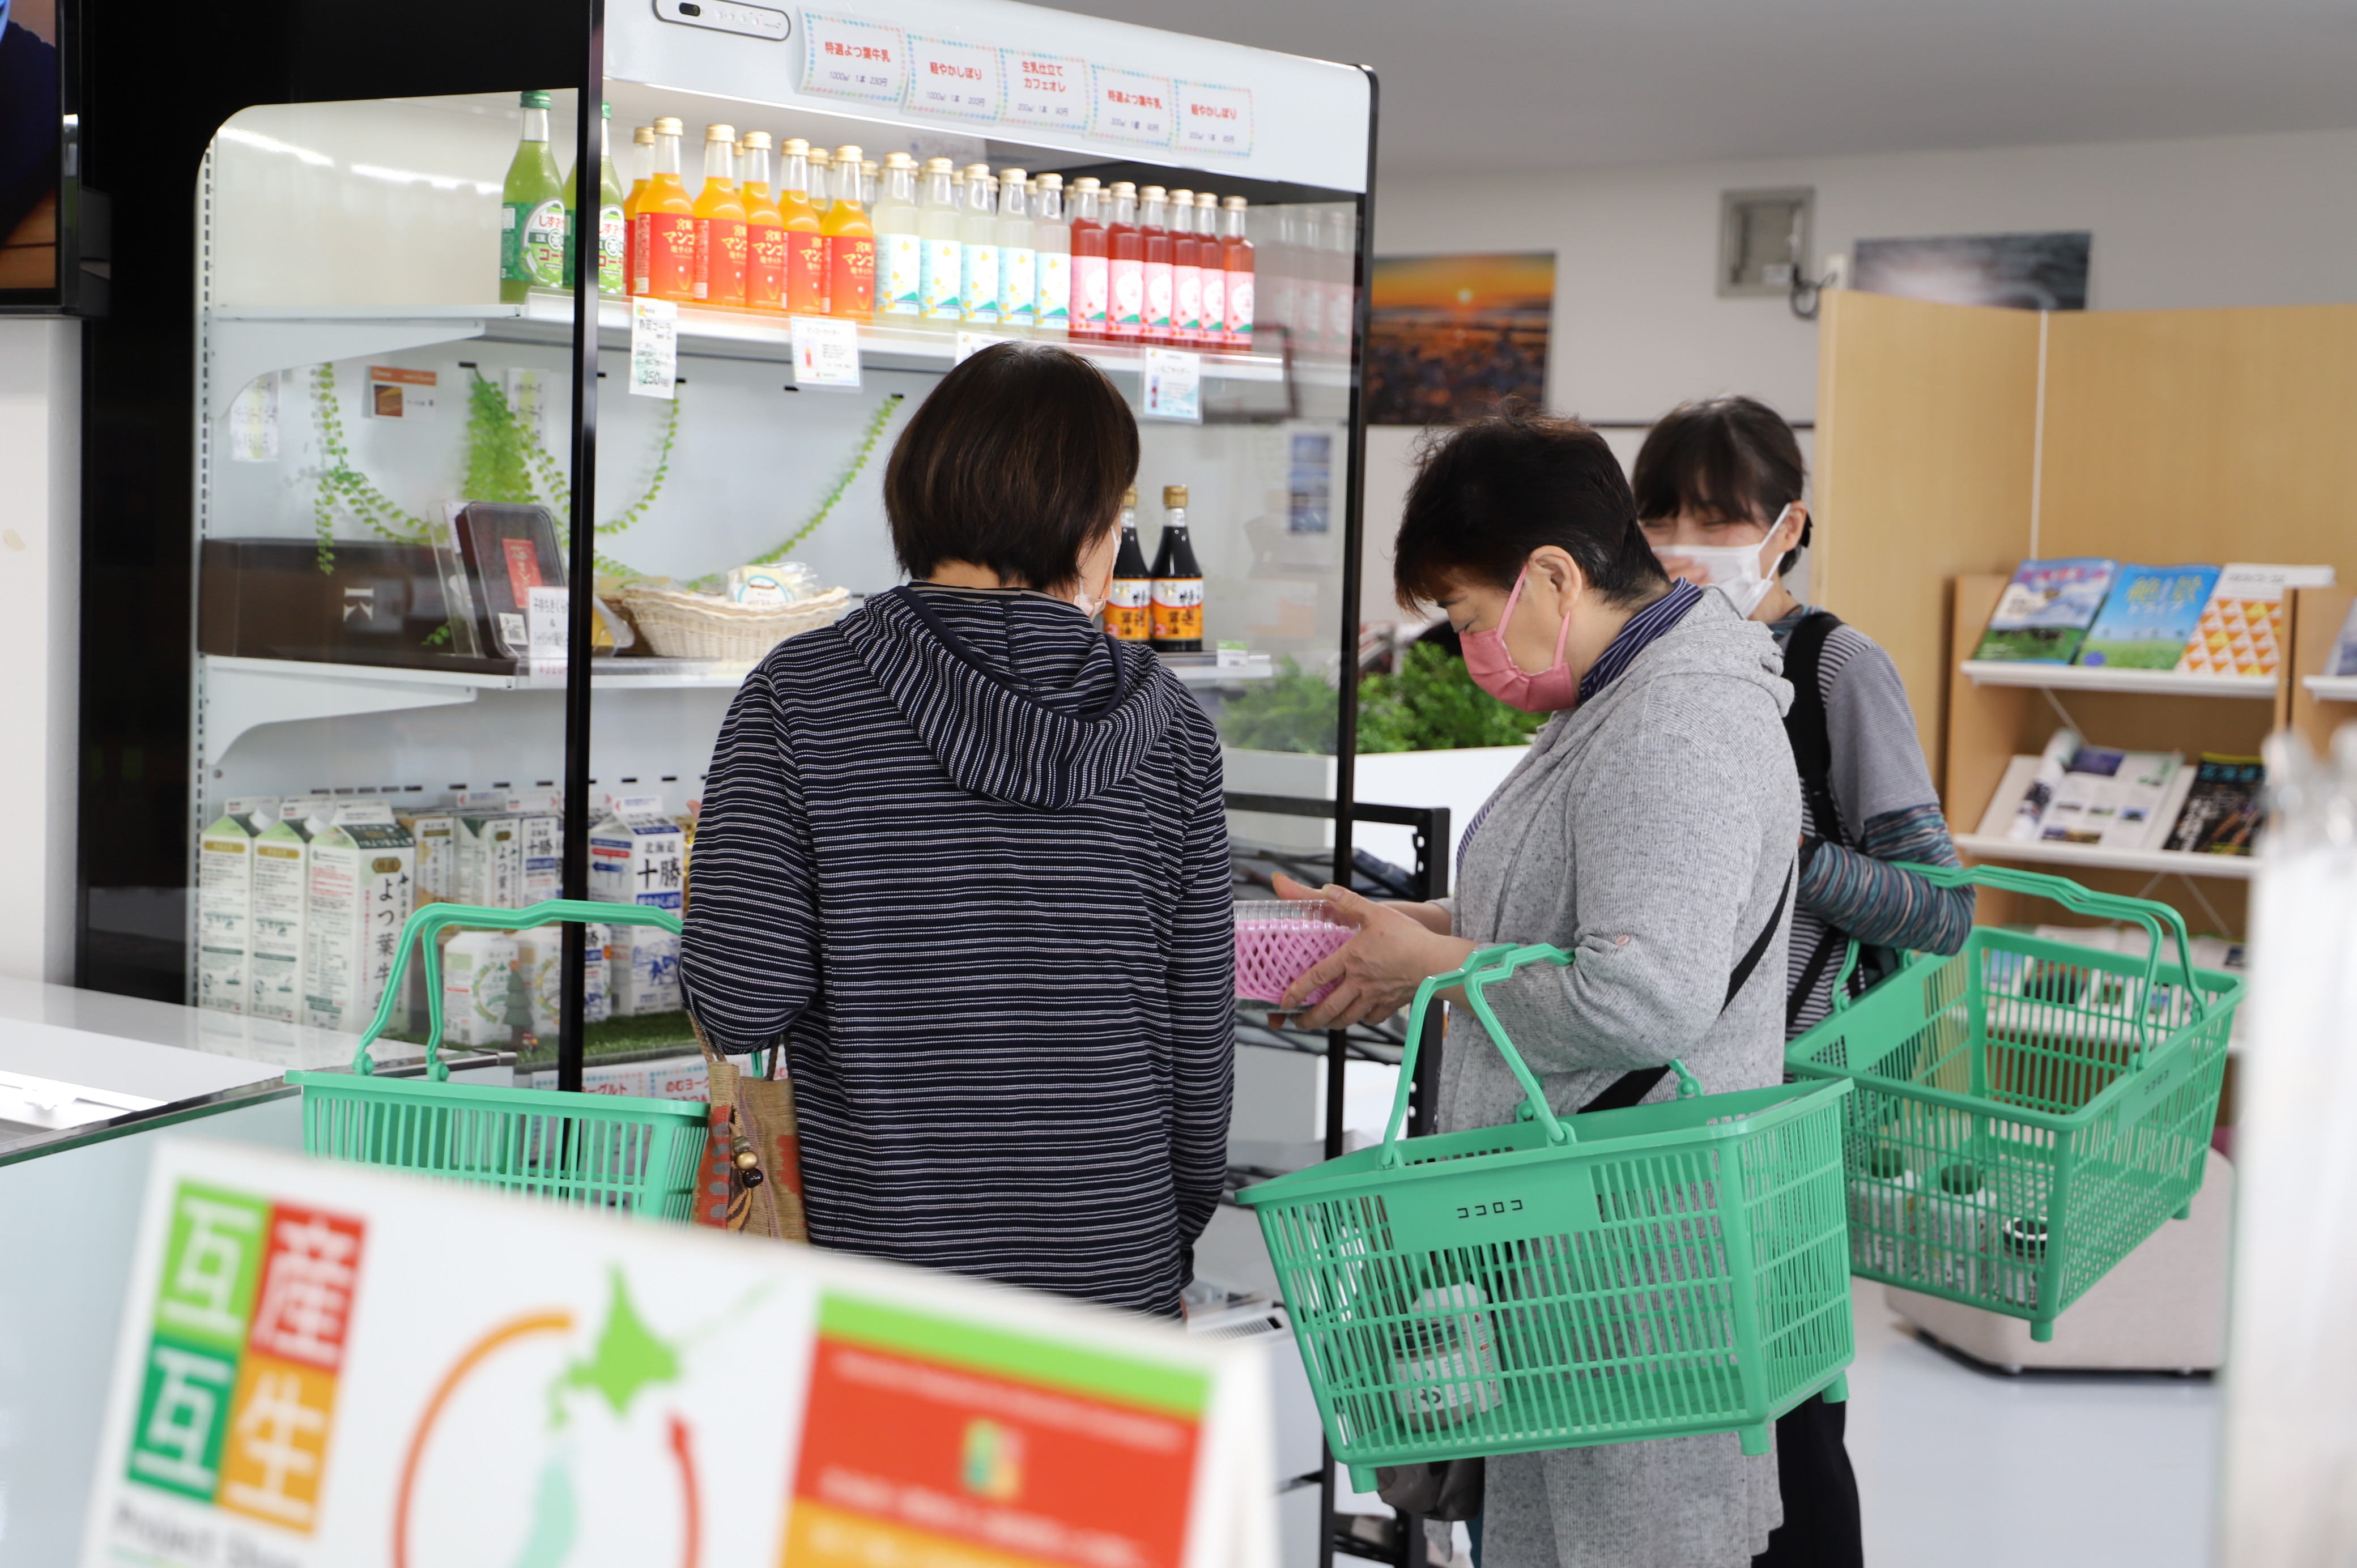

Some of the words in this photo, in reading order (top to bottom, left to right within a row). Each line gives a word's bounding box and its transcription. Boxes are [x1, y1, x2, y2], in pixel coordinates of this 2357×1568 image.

[1024, 78, 1066, 92] カフェオレ
[637, 856, 682, 891] 十勝
